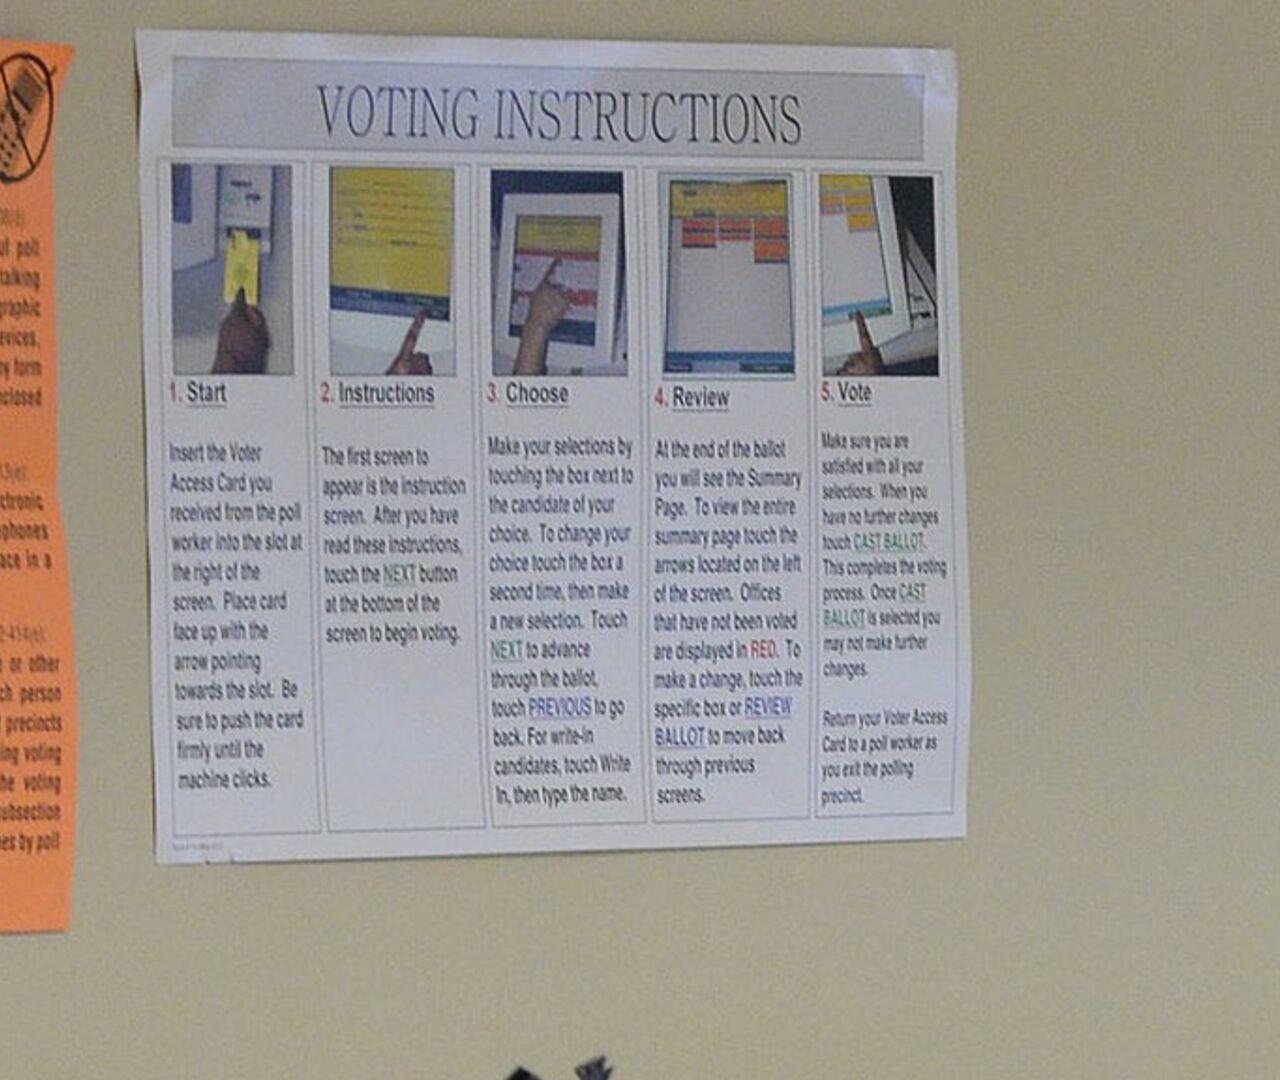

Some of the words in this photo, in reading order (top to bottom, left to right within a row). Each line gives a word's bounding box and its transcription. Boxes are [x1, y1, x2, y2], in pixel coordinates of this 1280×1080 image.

[317, 83, 480, 140] VOTING
[493, 89, 802, 147] INSTRUCTIONS
[170, 381, 182, 403] 1.
[187, 381, 227, 402] Start
[339, 382, 435, 402] Instructions
[507, 382, 568, 402] Choose
[655, 387, 668, 406] 4.
[673, 386, 730, 406] Review
[838, 381, 872, 401] Vote
[170, 442, 204, 462] Insert
[207, 442, 227, 462] the
[229, 441, 262, 462] Voter
[322, 447, 344, 465] The
[347, 447, 371, 465] first
[374, 450, 413, 465] screen
[416, 448, 428, 465] to
[489, 437, 519, 455] Make
[523, 439, 550, 459] your
[555, 437, 615, 455] selections
[618, 437, 632, 458] by
[655, 441, 669, 458] At
[672, 440, 690, 458] the
[693, 440, 715, 458] end
[717, 439, 728, 458] of
[732, 439, 751, 458] the
[754, 439, 785, 458] ballot
[171, 473, 213, 492] Access
[218, 473, 246, 492] Card
[249, 476, 273, 494] you
[323, 481, 363, 500] appear
[367, 478, 377, 495] is
[380, 478, 398, 495] the
[401, 476, 466, 495] instruction
[823, 510, 846, 525] have
[849, 512, 861, 525] no
[864, 508, 895, 525] further
[899, 510, 939, 528] changes
[823, 535, 851, 550] touch
[854, 533, 882, 549] CAST
[324, 566, 359, 583] touch
[362, 565, 380, 583] the
[384, 564, 416, 583] NEXT
[419, 565, 458, 583] button
[223, 591, 257, 610] Place
[259, 591, 287, 610] card
[490, 615, 497, 630] a
[500, 615, 524, 630] new
[591, 610, 628, 629] Touch
[491, 641, 523, 659] NEXT
[526, 642, 539, 658] to
[541, 641, 590, 659] advance
[655, 646, 672, 660] are
[676, 642, 732, 663] displayed
[736, 642, 747, 658] in
[751, 640, 780, 658] RED.
[787, 639, 801, 657] To
[11, 659, 22, 672] or
[29, 656, 59, 672] other
[20, 688, 61, 705] person
[492, 700, 525, 717] touch
[529, 697, 591, 715] PREVIOUS
[594, 699, 606, 715] to
[609, 702, 625, 719] go
[655, 699, 699, 719] specific
[704, 698, 725, 716] box
[729, 703, 742, 716] or
[745, 697, 792, 715] REVIEW
[824, 710, 856, 726] Return
[859, 713, 880, 729] your
[884, 710, 910, 725] Voter
[913, 709, 948, 725] Access
[655, 727, 705, 746] BALLOT
[708, 730, 719, 745] to
[723, 730, 754, 745] move
[758, 726, 786, 743] back
[178, 771, 229, 789] machine
